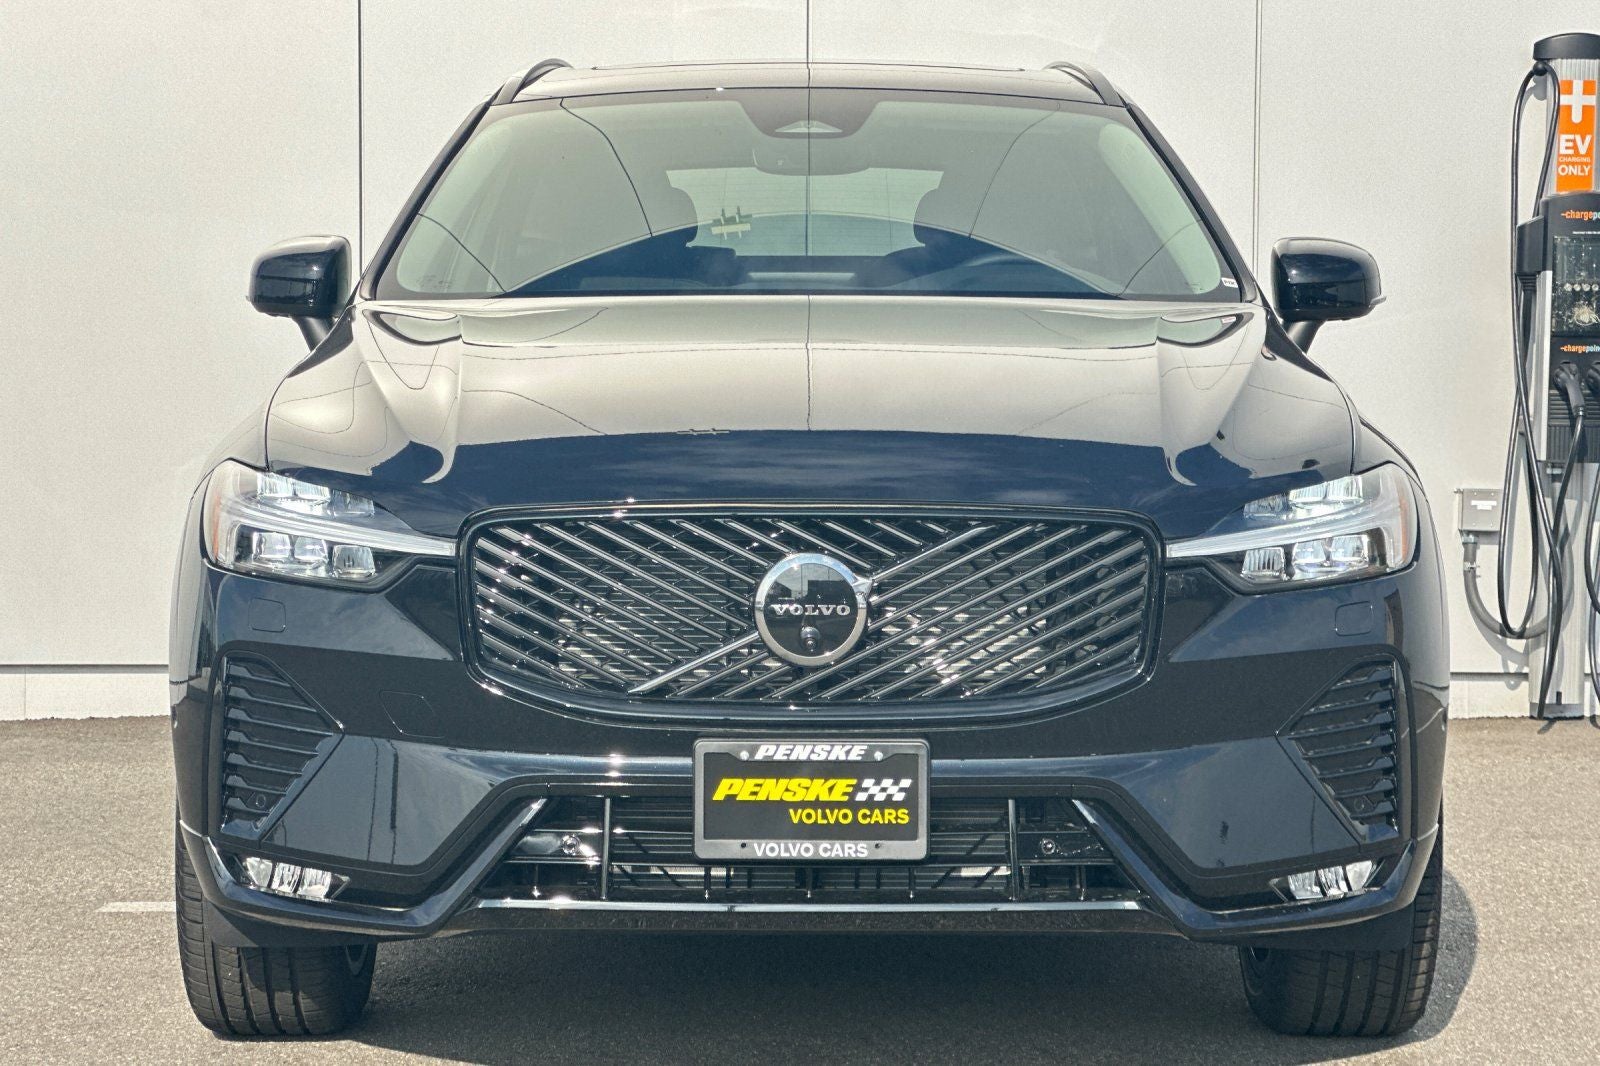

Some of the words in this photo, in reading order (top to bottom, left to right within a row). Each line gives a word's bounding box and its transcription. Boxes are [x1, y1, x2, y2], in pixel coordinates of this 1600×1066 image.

[1559, 134, 1592, 155] EV
[1558, 164, 1591, 176] ONLY
[768, 604, 851, 616] VOLVO
[754, 744, 868, 761] PENSKE
[712, 778, 858, 802] PENSKE
[789, 808, 853, 825] VOLVO
[857, 808, 910, 825] CARS
[753, 842, 815, 858] VOLVO
[818, 842, 869, 858] CARS
